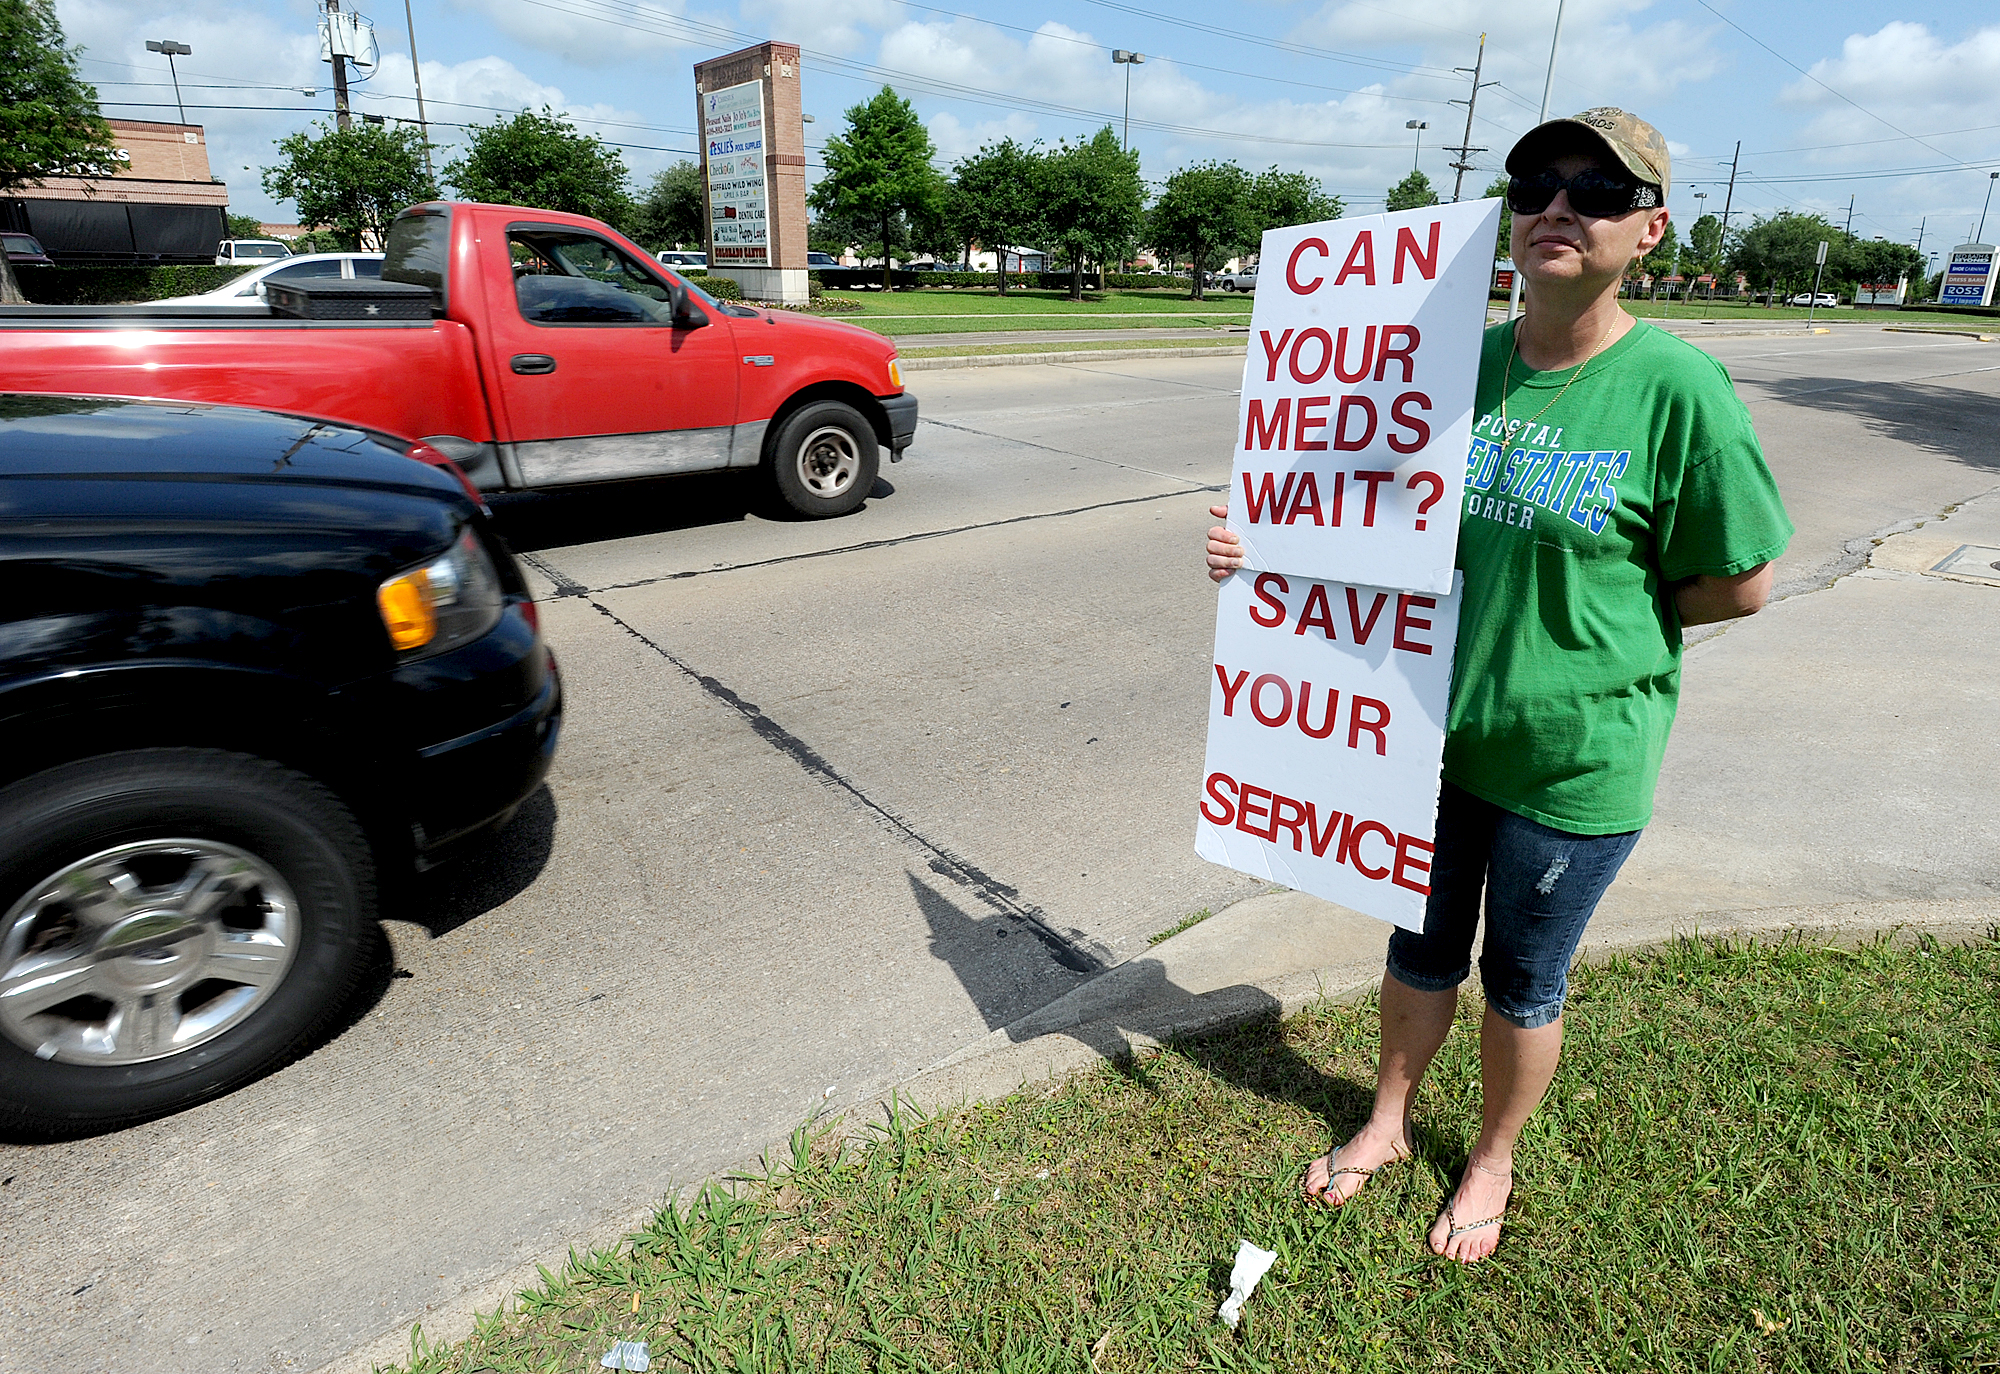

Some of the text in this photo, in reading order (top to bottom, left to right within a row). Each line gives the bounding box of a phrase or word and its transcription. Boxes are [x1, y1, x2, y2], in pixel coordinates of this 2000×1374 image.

[709, 138, 762, 156] LESLIE'S POOL SUPPLIES
[710, 182, 731, 192] BUFFALO
[732, 180, 746, 189] WILD
[724, 191, 735, 199] GRILL
[740, 189, 750, 198] BAR
[738, 209, 766, 220] DENTAL CARE
[1287, 222, 1440, 295] CAN
[1947, 286, 1980, 295] ROSS
[1260, 325, 1420, 384] YOUR
[1245, 392, 1431, 453] MEDS
[1474, 413, 1564, 448] POSTAL
[1243, 471, 1444, 530] WAIT?
[1462, 491, 1535, 530] ORKER
[1500, 447, 1632, 536] STATES
[1250, 573, 1434, 654] SAVE
[1215, 664, 1391, 755] YOUR
[1200, 773, 1435, 896] SERVICE
